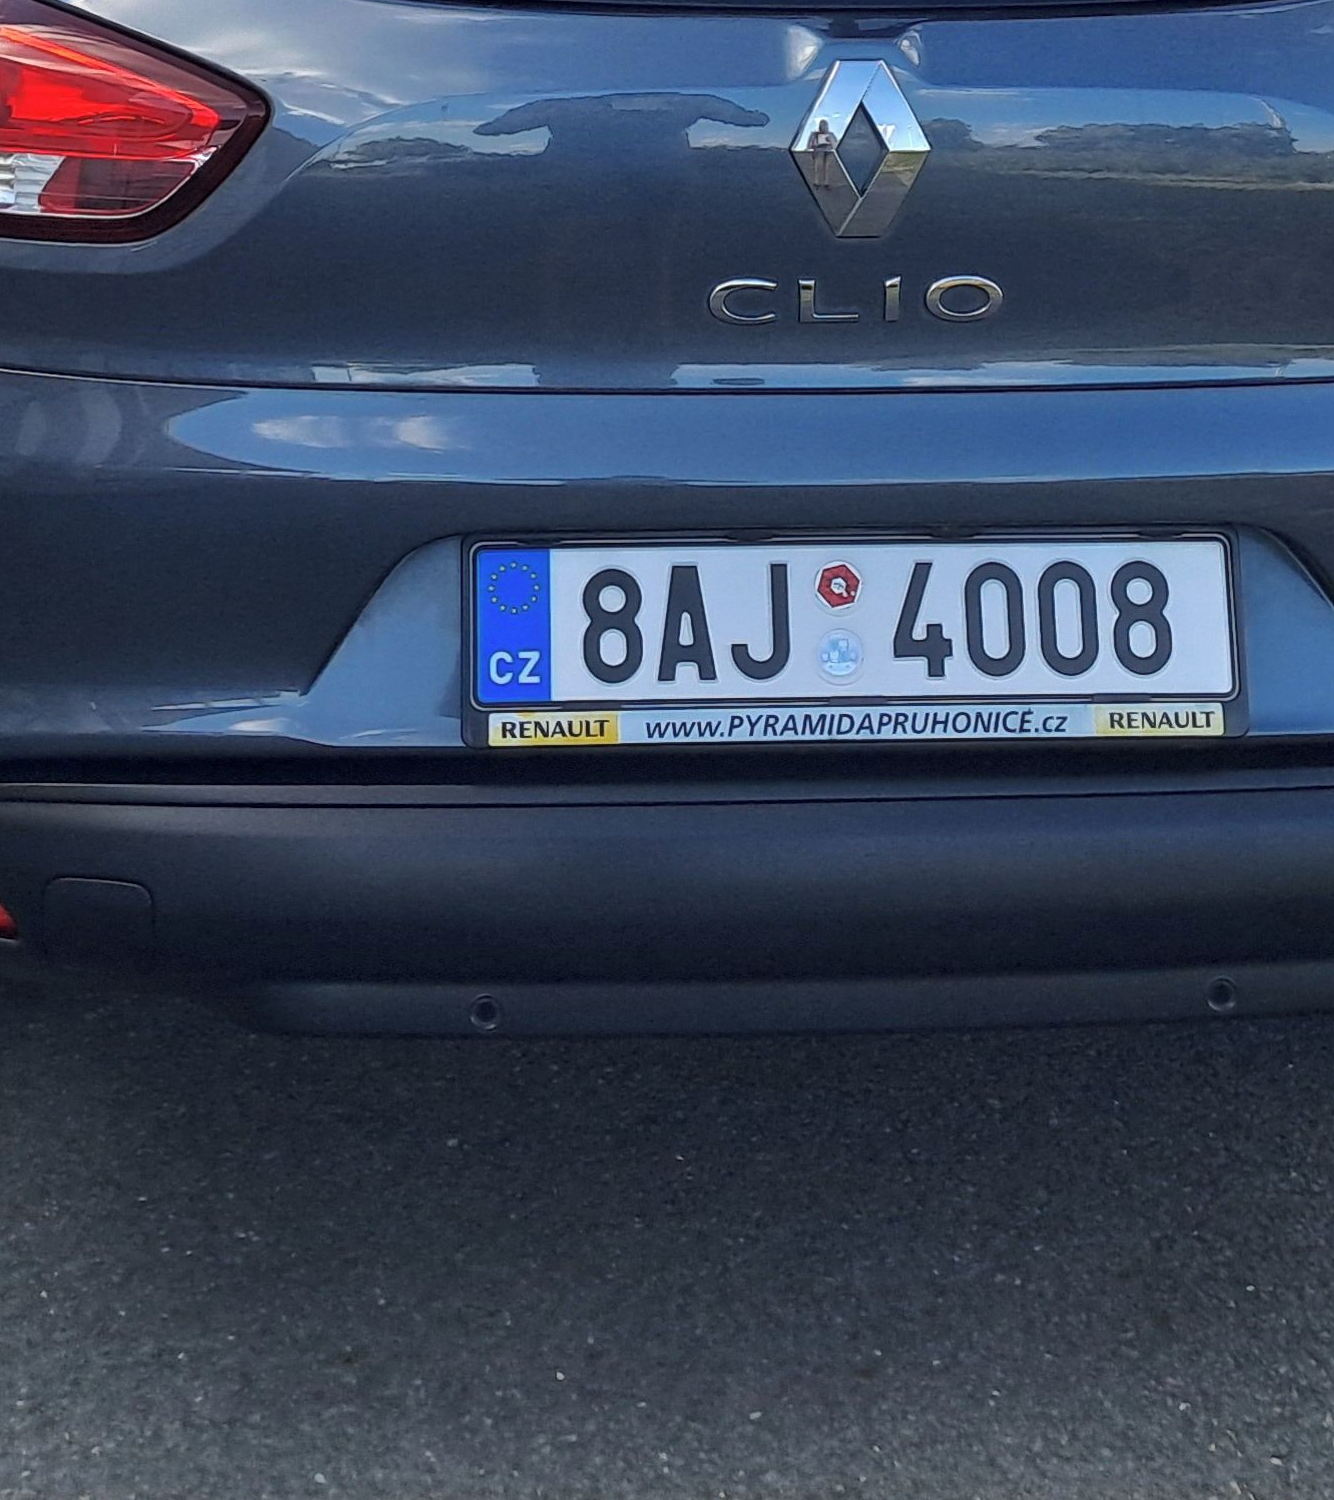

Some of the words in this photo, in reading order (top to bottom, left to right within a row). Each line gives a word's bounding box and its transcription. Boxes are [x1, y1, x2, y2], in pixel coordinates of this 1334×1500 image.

[709, 275, 1004, 324] CLIO
[581, 563, 792, 684] 8AJ
[893, 560, 1173, 679] 4008
[489, 650, 541, 685] CZ
[501, 718, 610, 739] RENAULT
[1108, 710, 1216, 730] RENAULT
